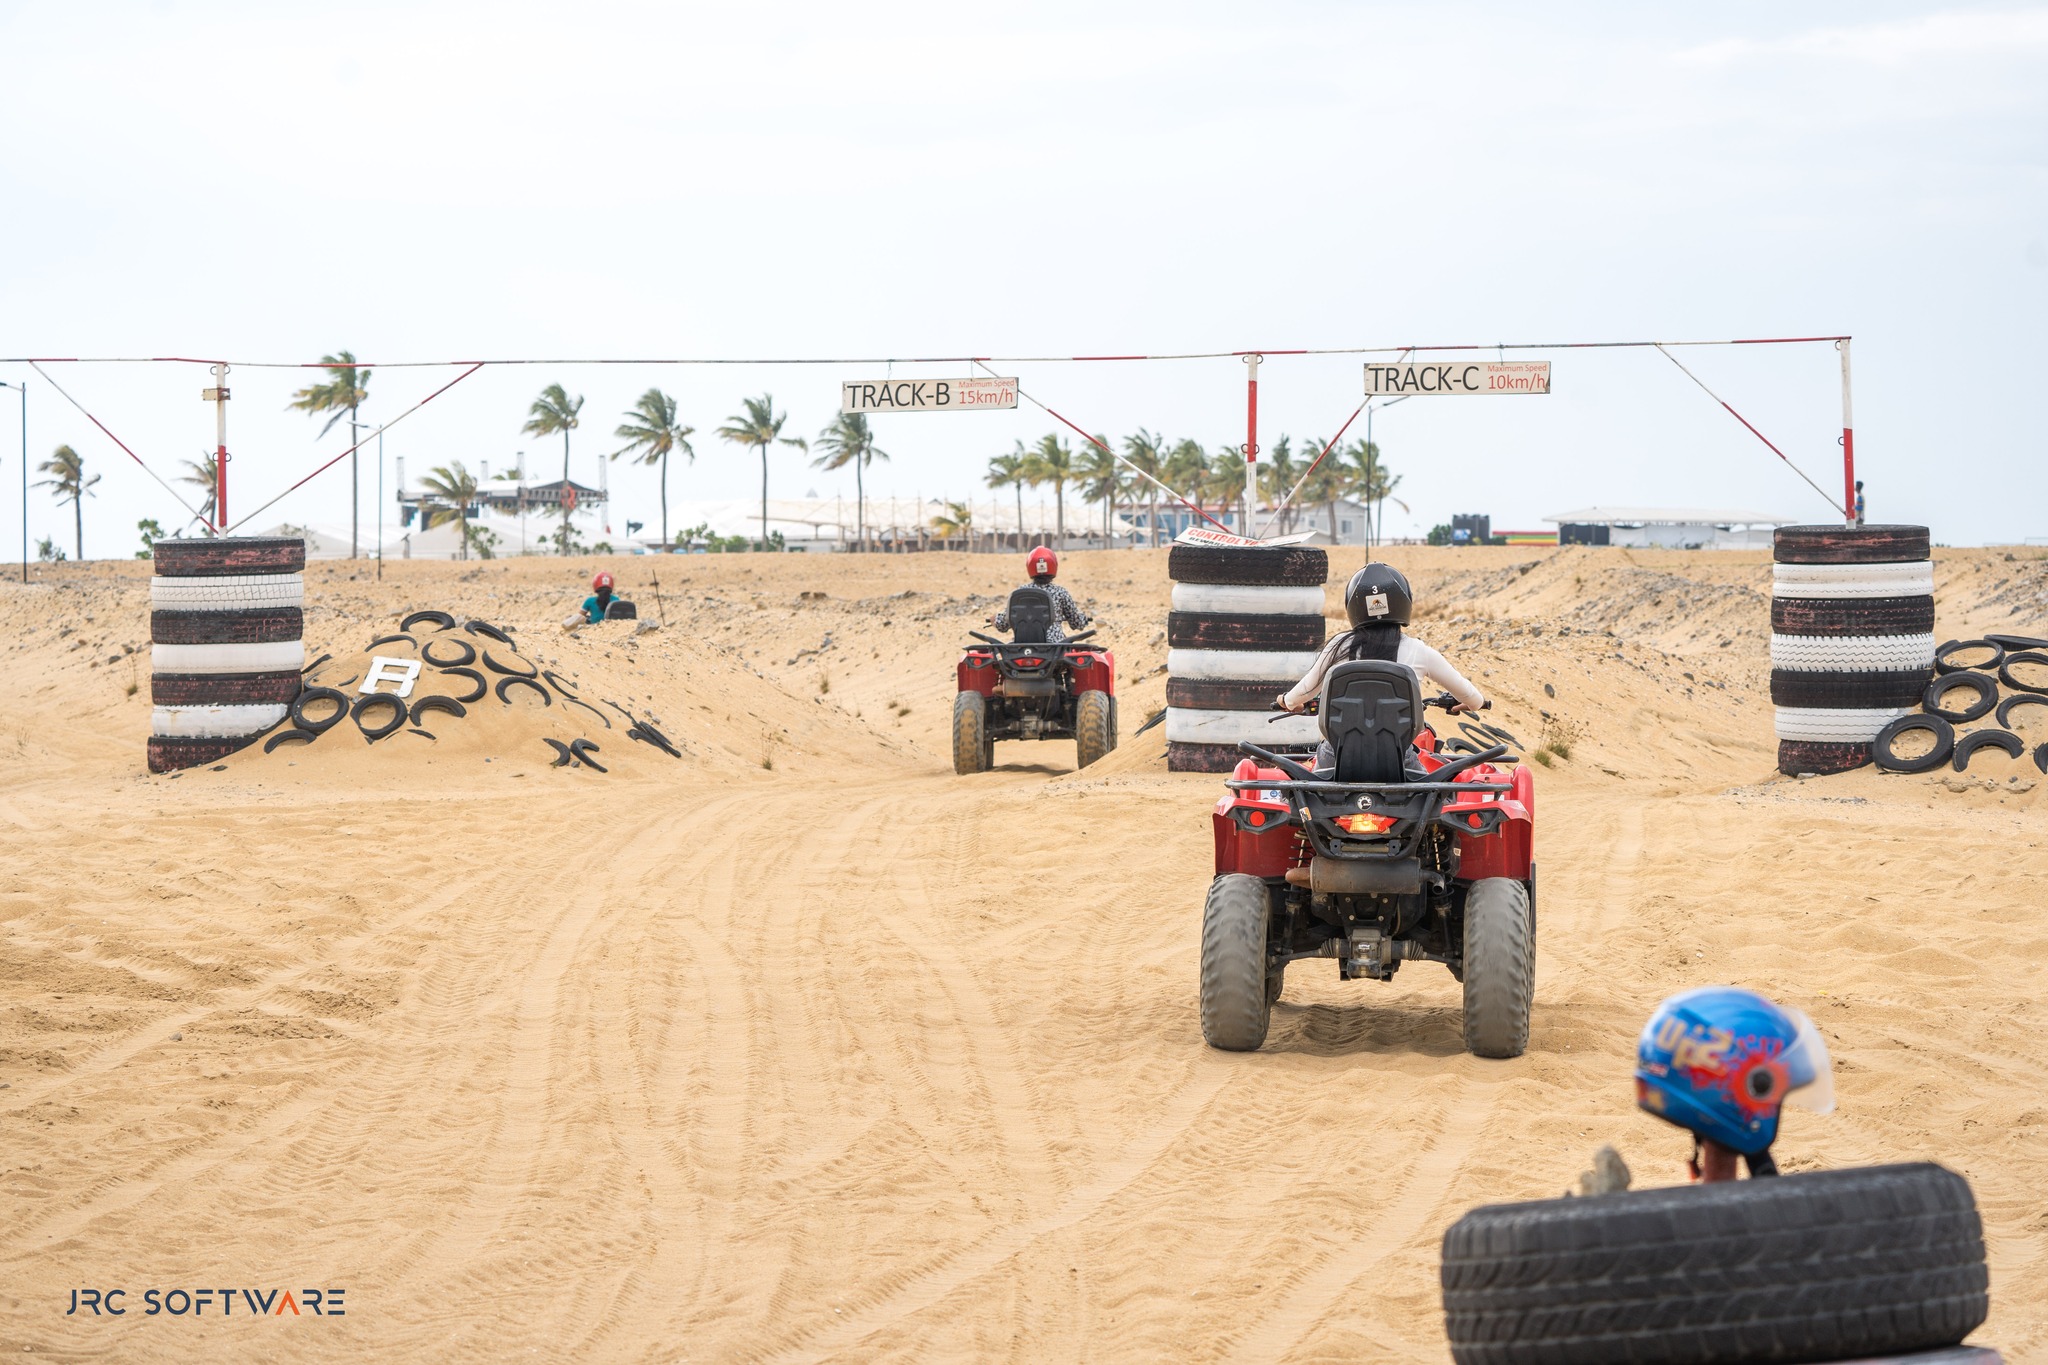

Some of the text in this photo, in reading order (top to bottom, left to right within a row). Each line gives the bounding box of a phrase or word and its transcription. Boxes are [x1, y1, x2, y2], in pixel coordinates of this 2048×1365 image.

[1525, 364, 1547, 372] Speed
[959, 379, 1015, 388] Maximum Speed
[1369, 366, 1479, 391] TRACK-C
[1488, 373, 1546, 391] 10km/h
[847, 383, 950, 408] TRACK-B
[959, 388, 1013, 405] 15km/h
[1187, 529, 1241, 545] CONTROL
[1371, 585, 1379, 594] 3
